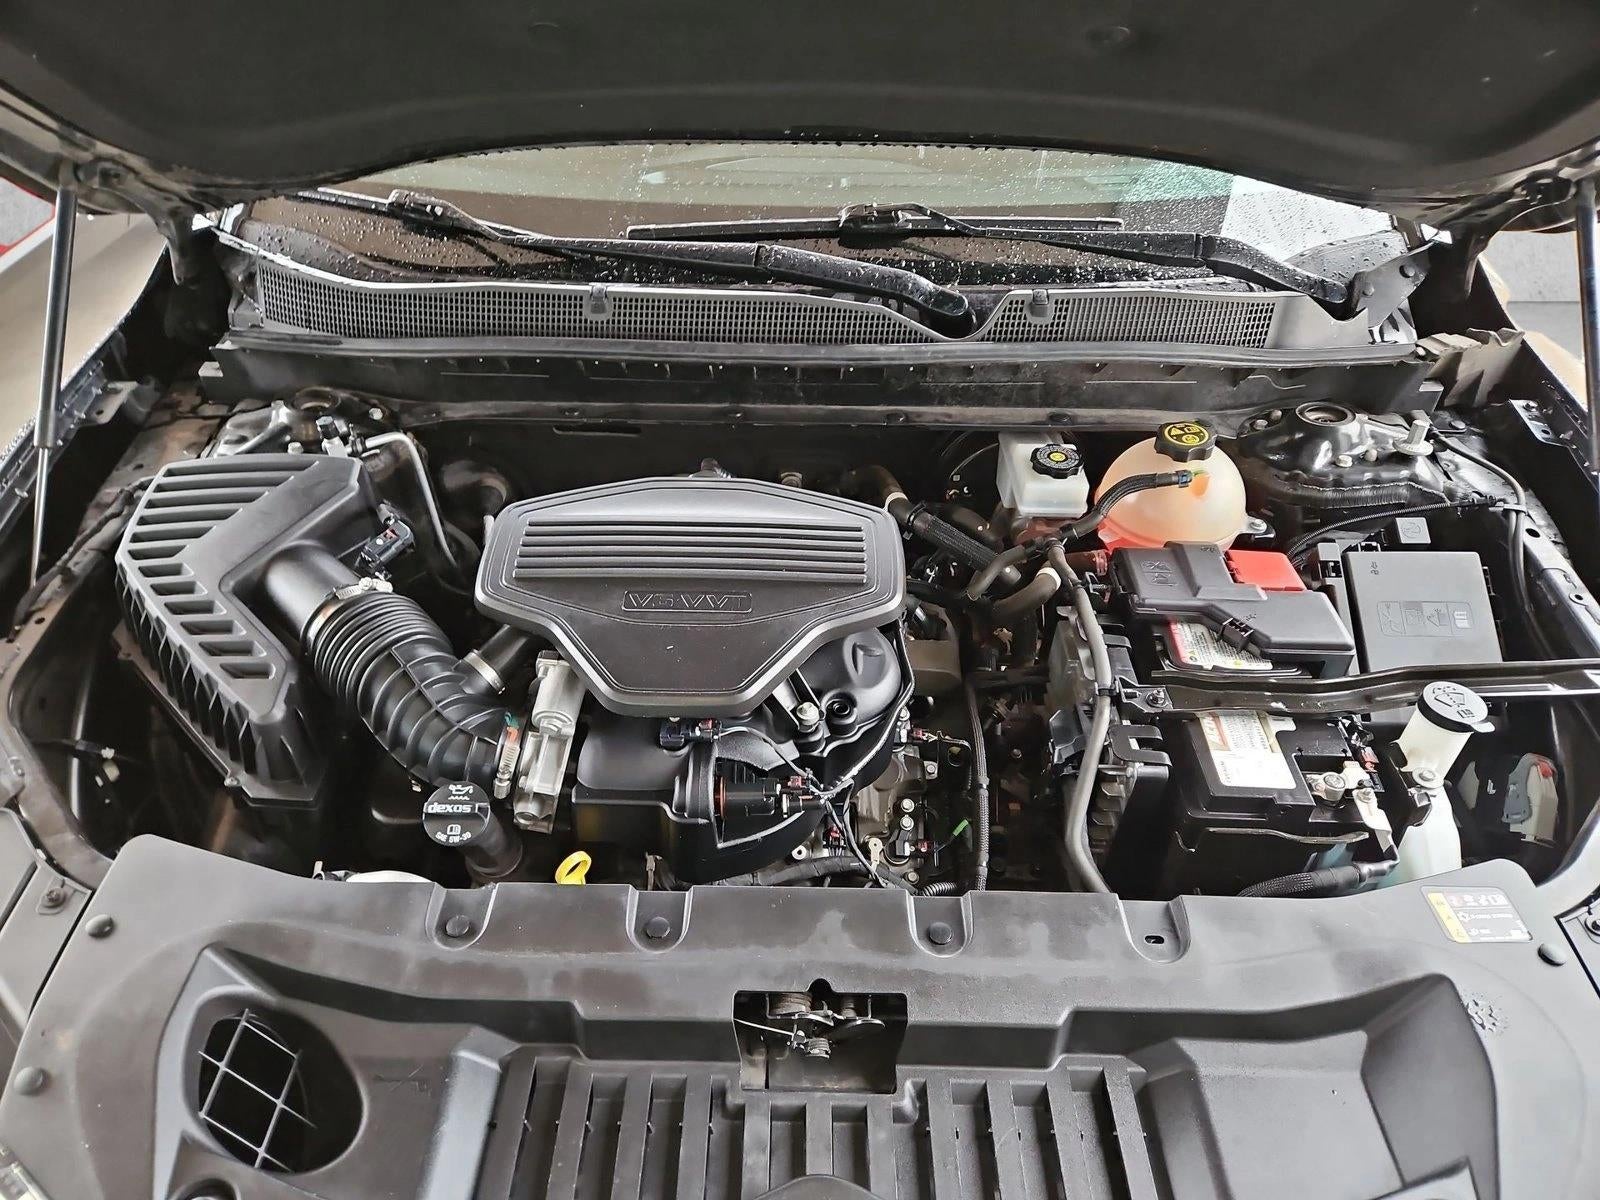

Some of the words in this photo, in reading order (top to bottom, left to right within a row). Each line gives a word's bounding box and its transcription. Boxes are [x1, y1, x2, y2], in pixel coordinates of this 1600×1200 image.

[679, 593, 748, 609] VVT
[427, 801, 473, 814] dexos
[435, 831, 448, 842] SAE
[448, 831, 472, 843] 5W-30
